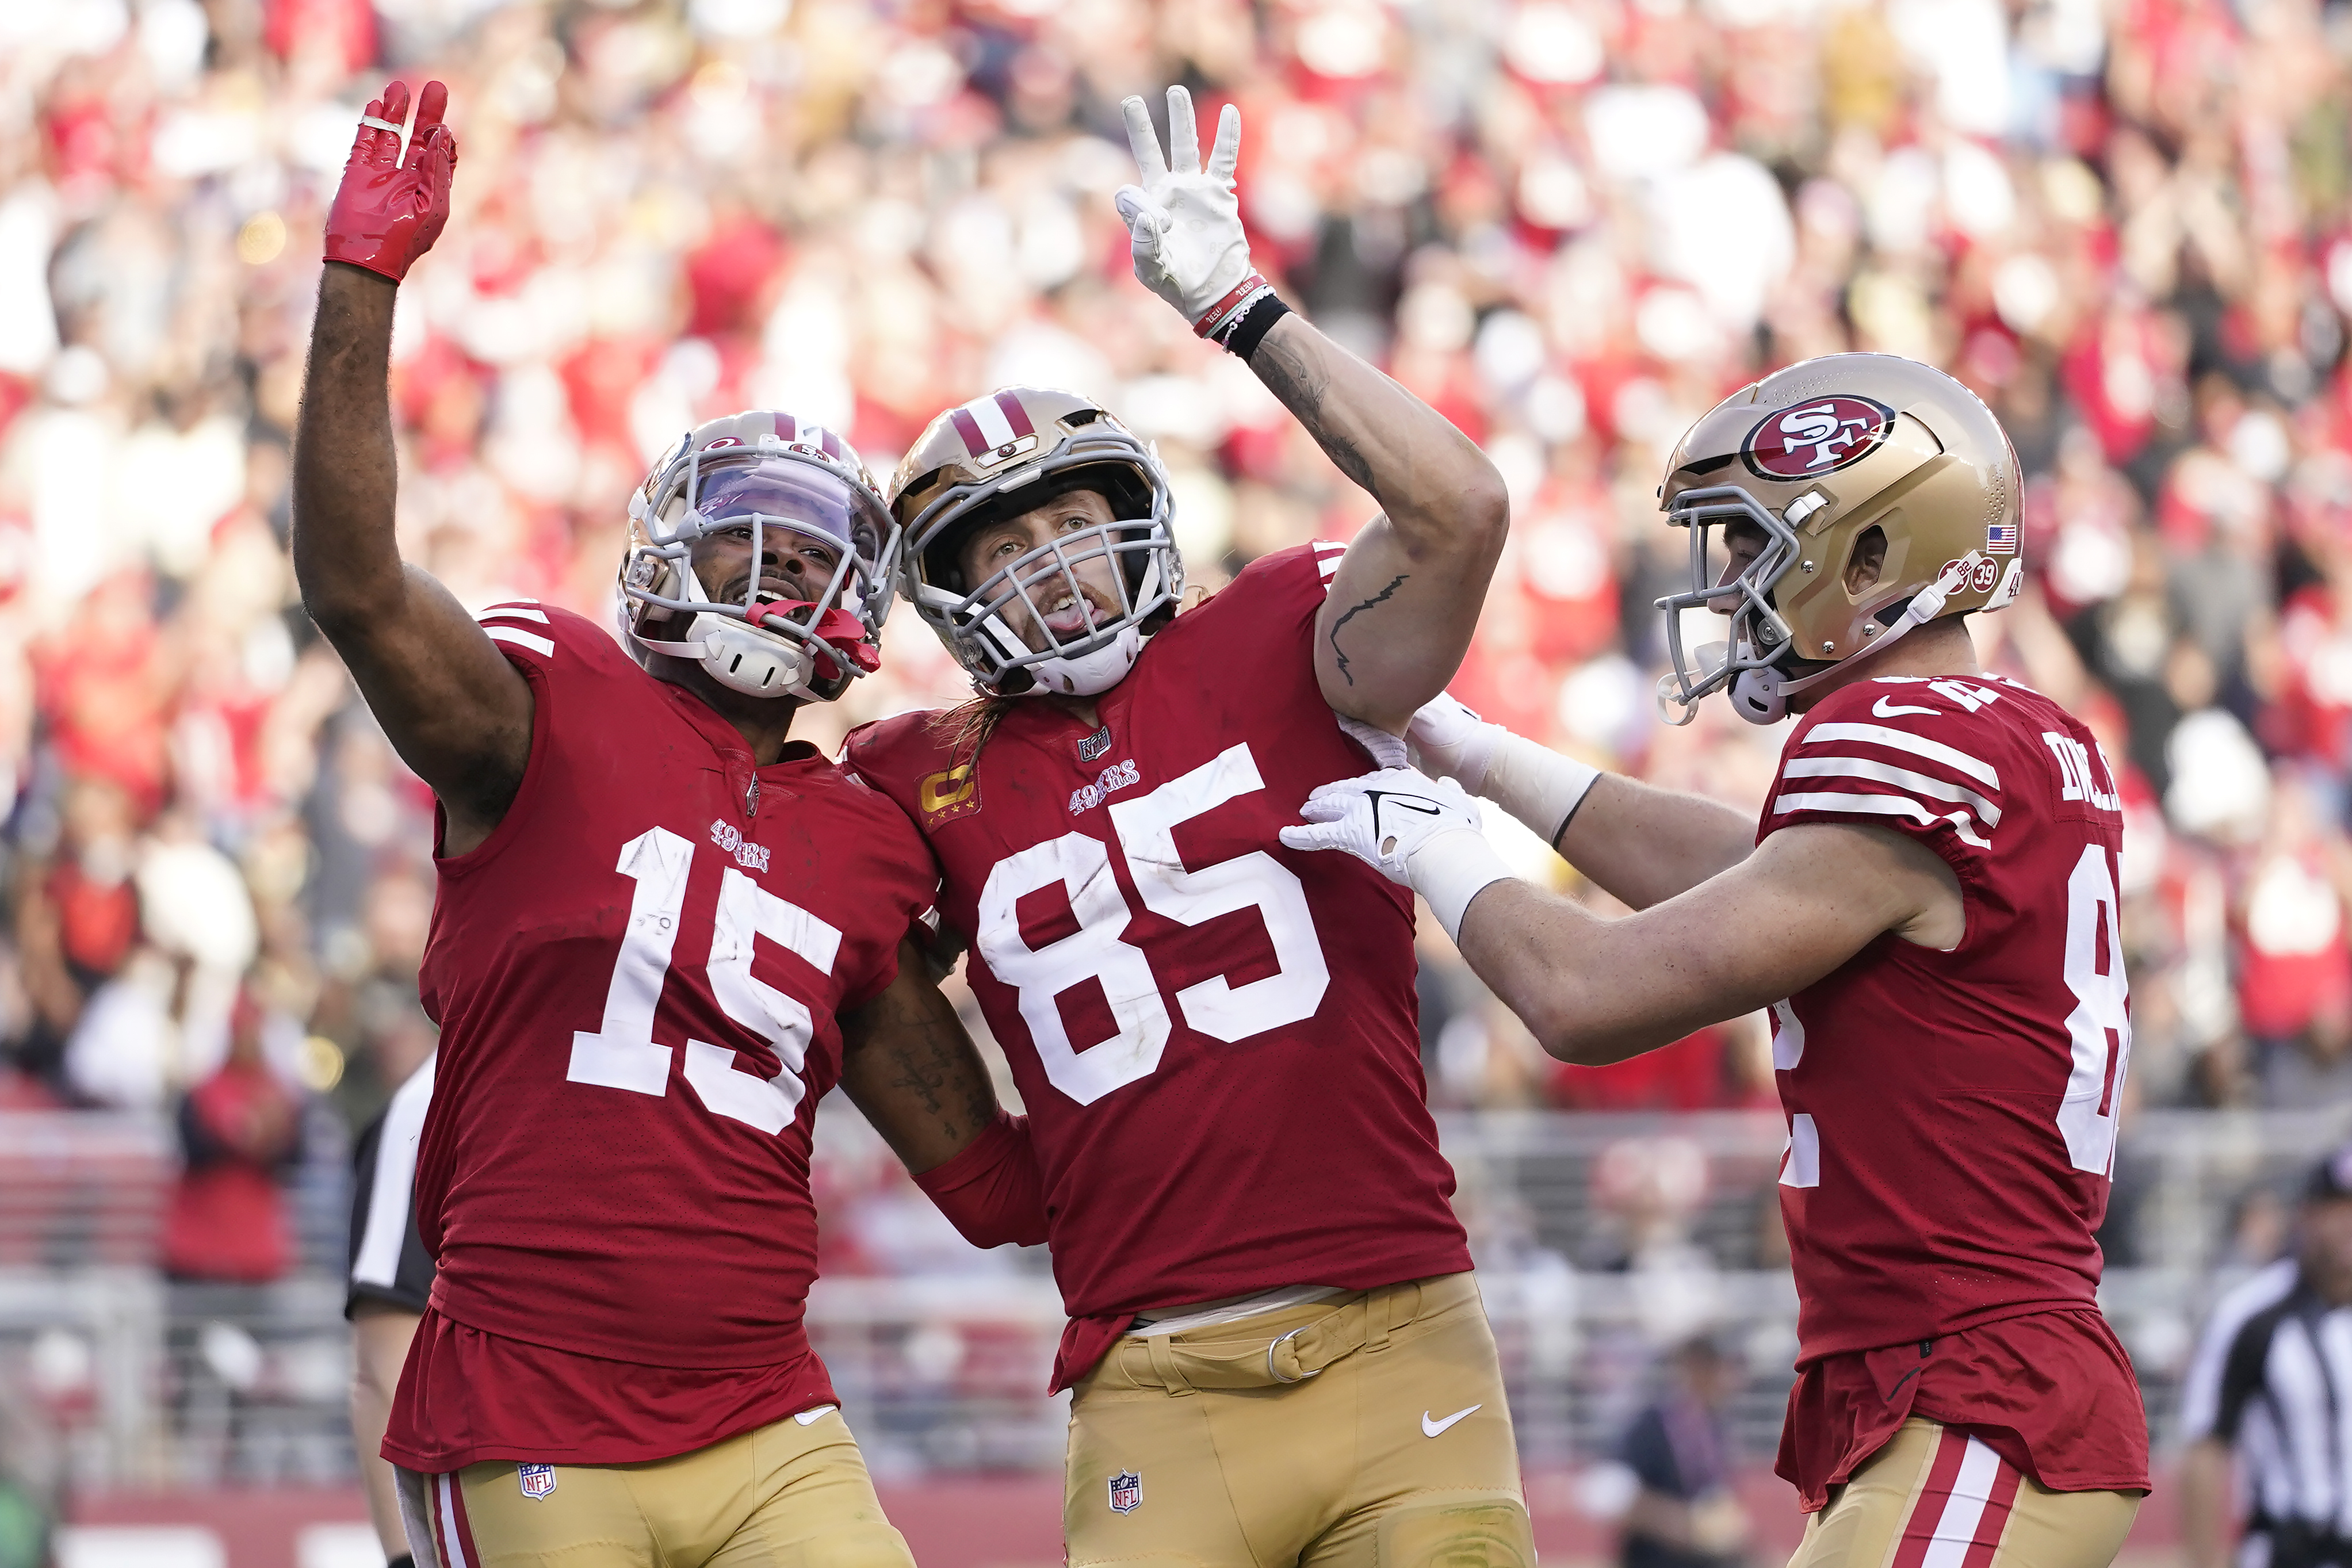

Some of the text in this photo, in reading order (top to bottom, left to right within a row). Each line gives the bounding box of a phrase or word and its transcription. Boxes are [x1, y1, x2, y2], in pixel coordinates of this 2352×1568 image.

[1779, 403, 1868, 469] SF
[1957, 561, 1972, 576] 82
[1974, 564, 1995, 585] 39
[1084, 737, 1106, 758] NFL
[920, 764, 975, 813] C
[1068, 758, 1141, 816] 49ERS
[977, 741, 1330, 1107] 85
[566, 825, 843, 1136] 15
[2055, 842, 2132, 1183] 8
[525, 1474, 551, 1492] NFL
[1114, 1489, 1137, 1507] NFL
